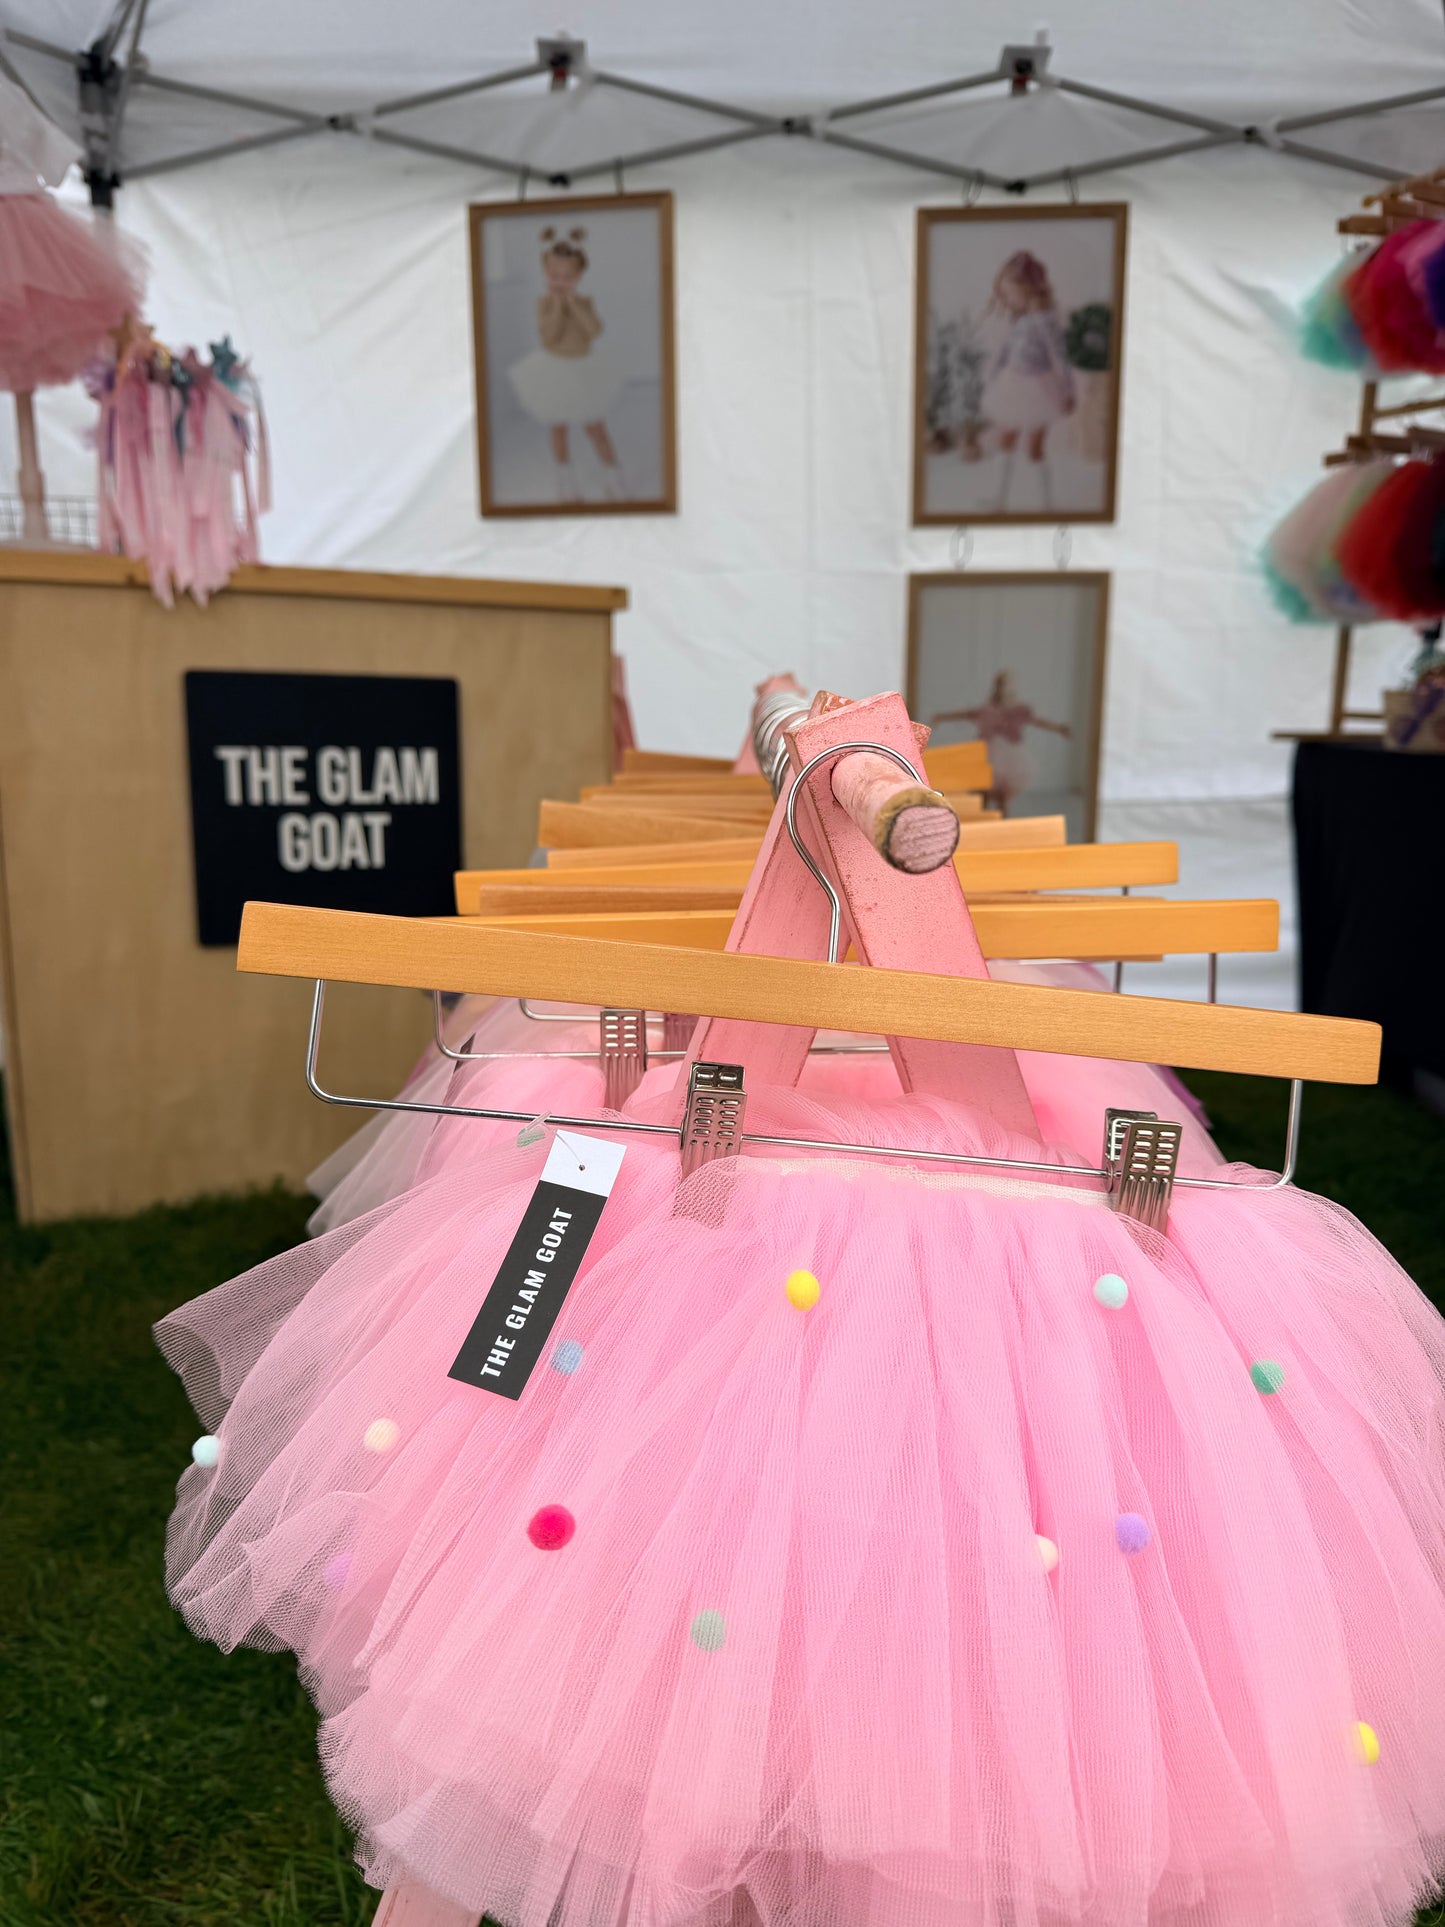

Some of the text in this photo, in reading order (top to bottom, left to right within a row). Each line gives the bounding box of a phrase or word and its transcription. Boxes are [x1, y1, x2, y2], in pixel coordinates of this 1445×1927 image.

[215, 745, 440, 806] THE GLAM
[278, 812, 392, 872] GOAT
[480, 1207, 573, 1378] THE GLAM GOAT
